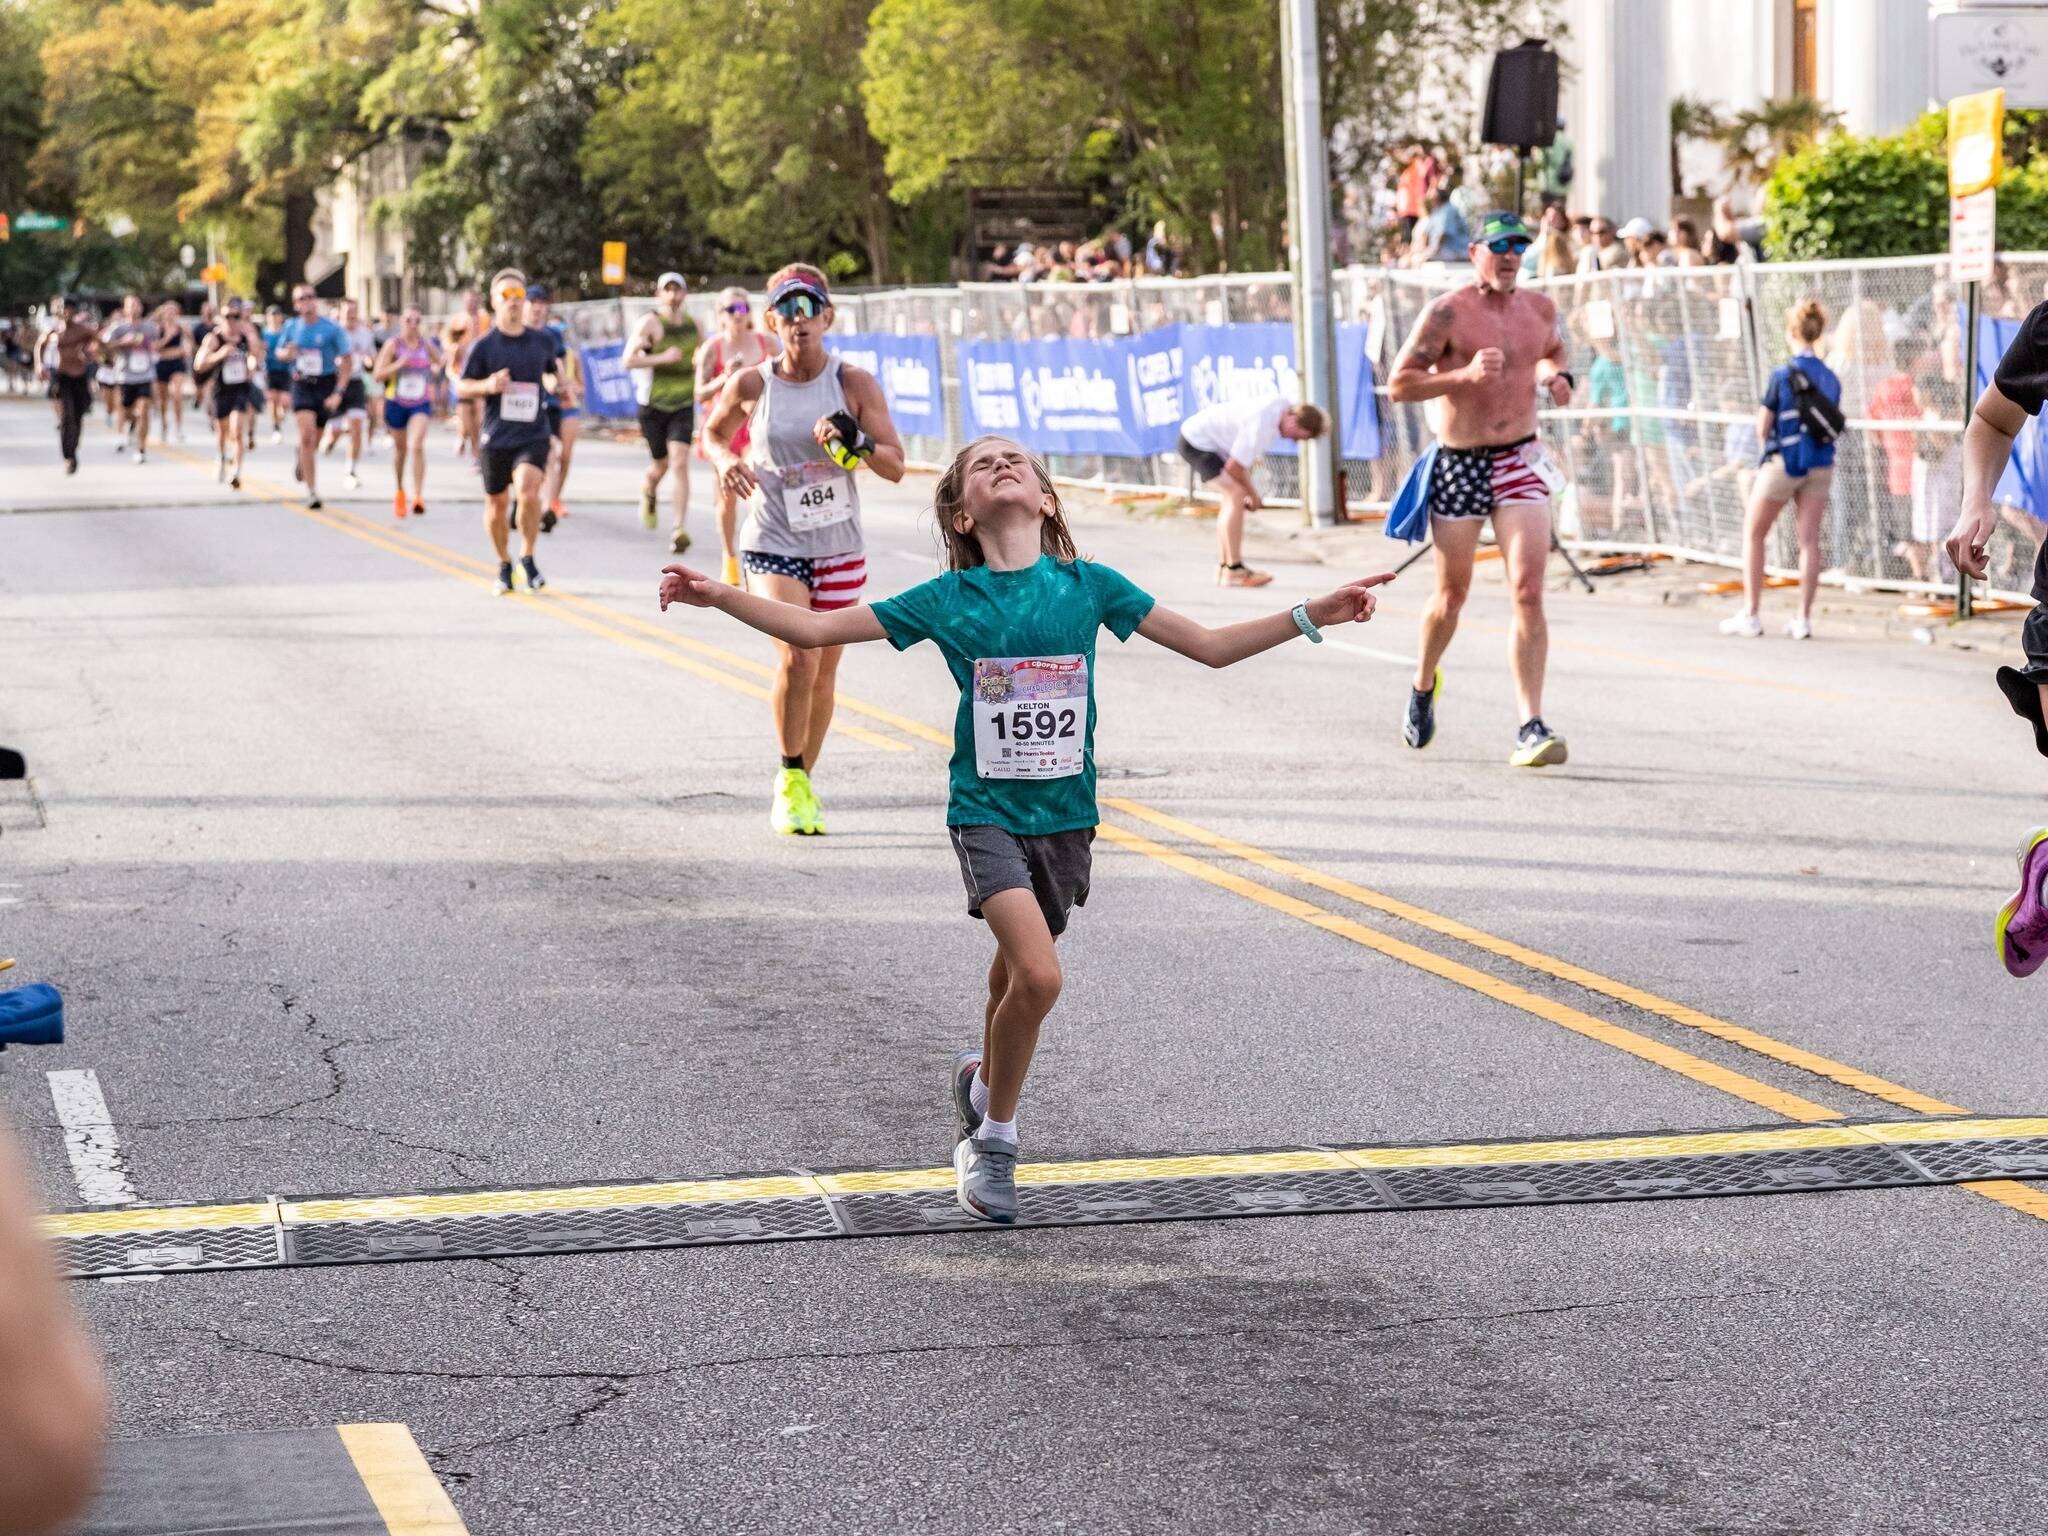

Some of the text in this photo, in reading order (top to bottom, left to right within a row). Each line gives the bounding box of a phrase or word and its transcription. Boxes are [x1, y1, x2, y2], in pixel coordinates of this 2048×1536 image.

[800, 486, 834, 507] 484
[1031, 661, 1058, 670] COOPER
[980, 676, 1010, 687] BRIDGE
[1017, 702, 1050, 710] KELTON
[991, 709, 1075, 740] 1592
